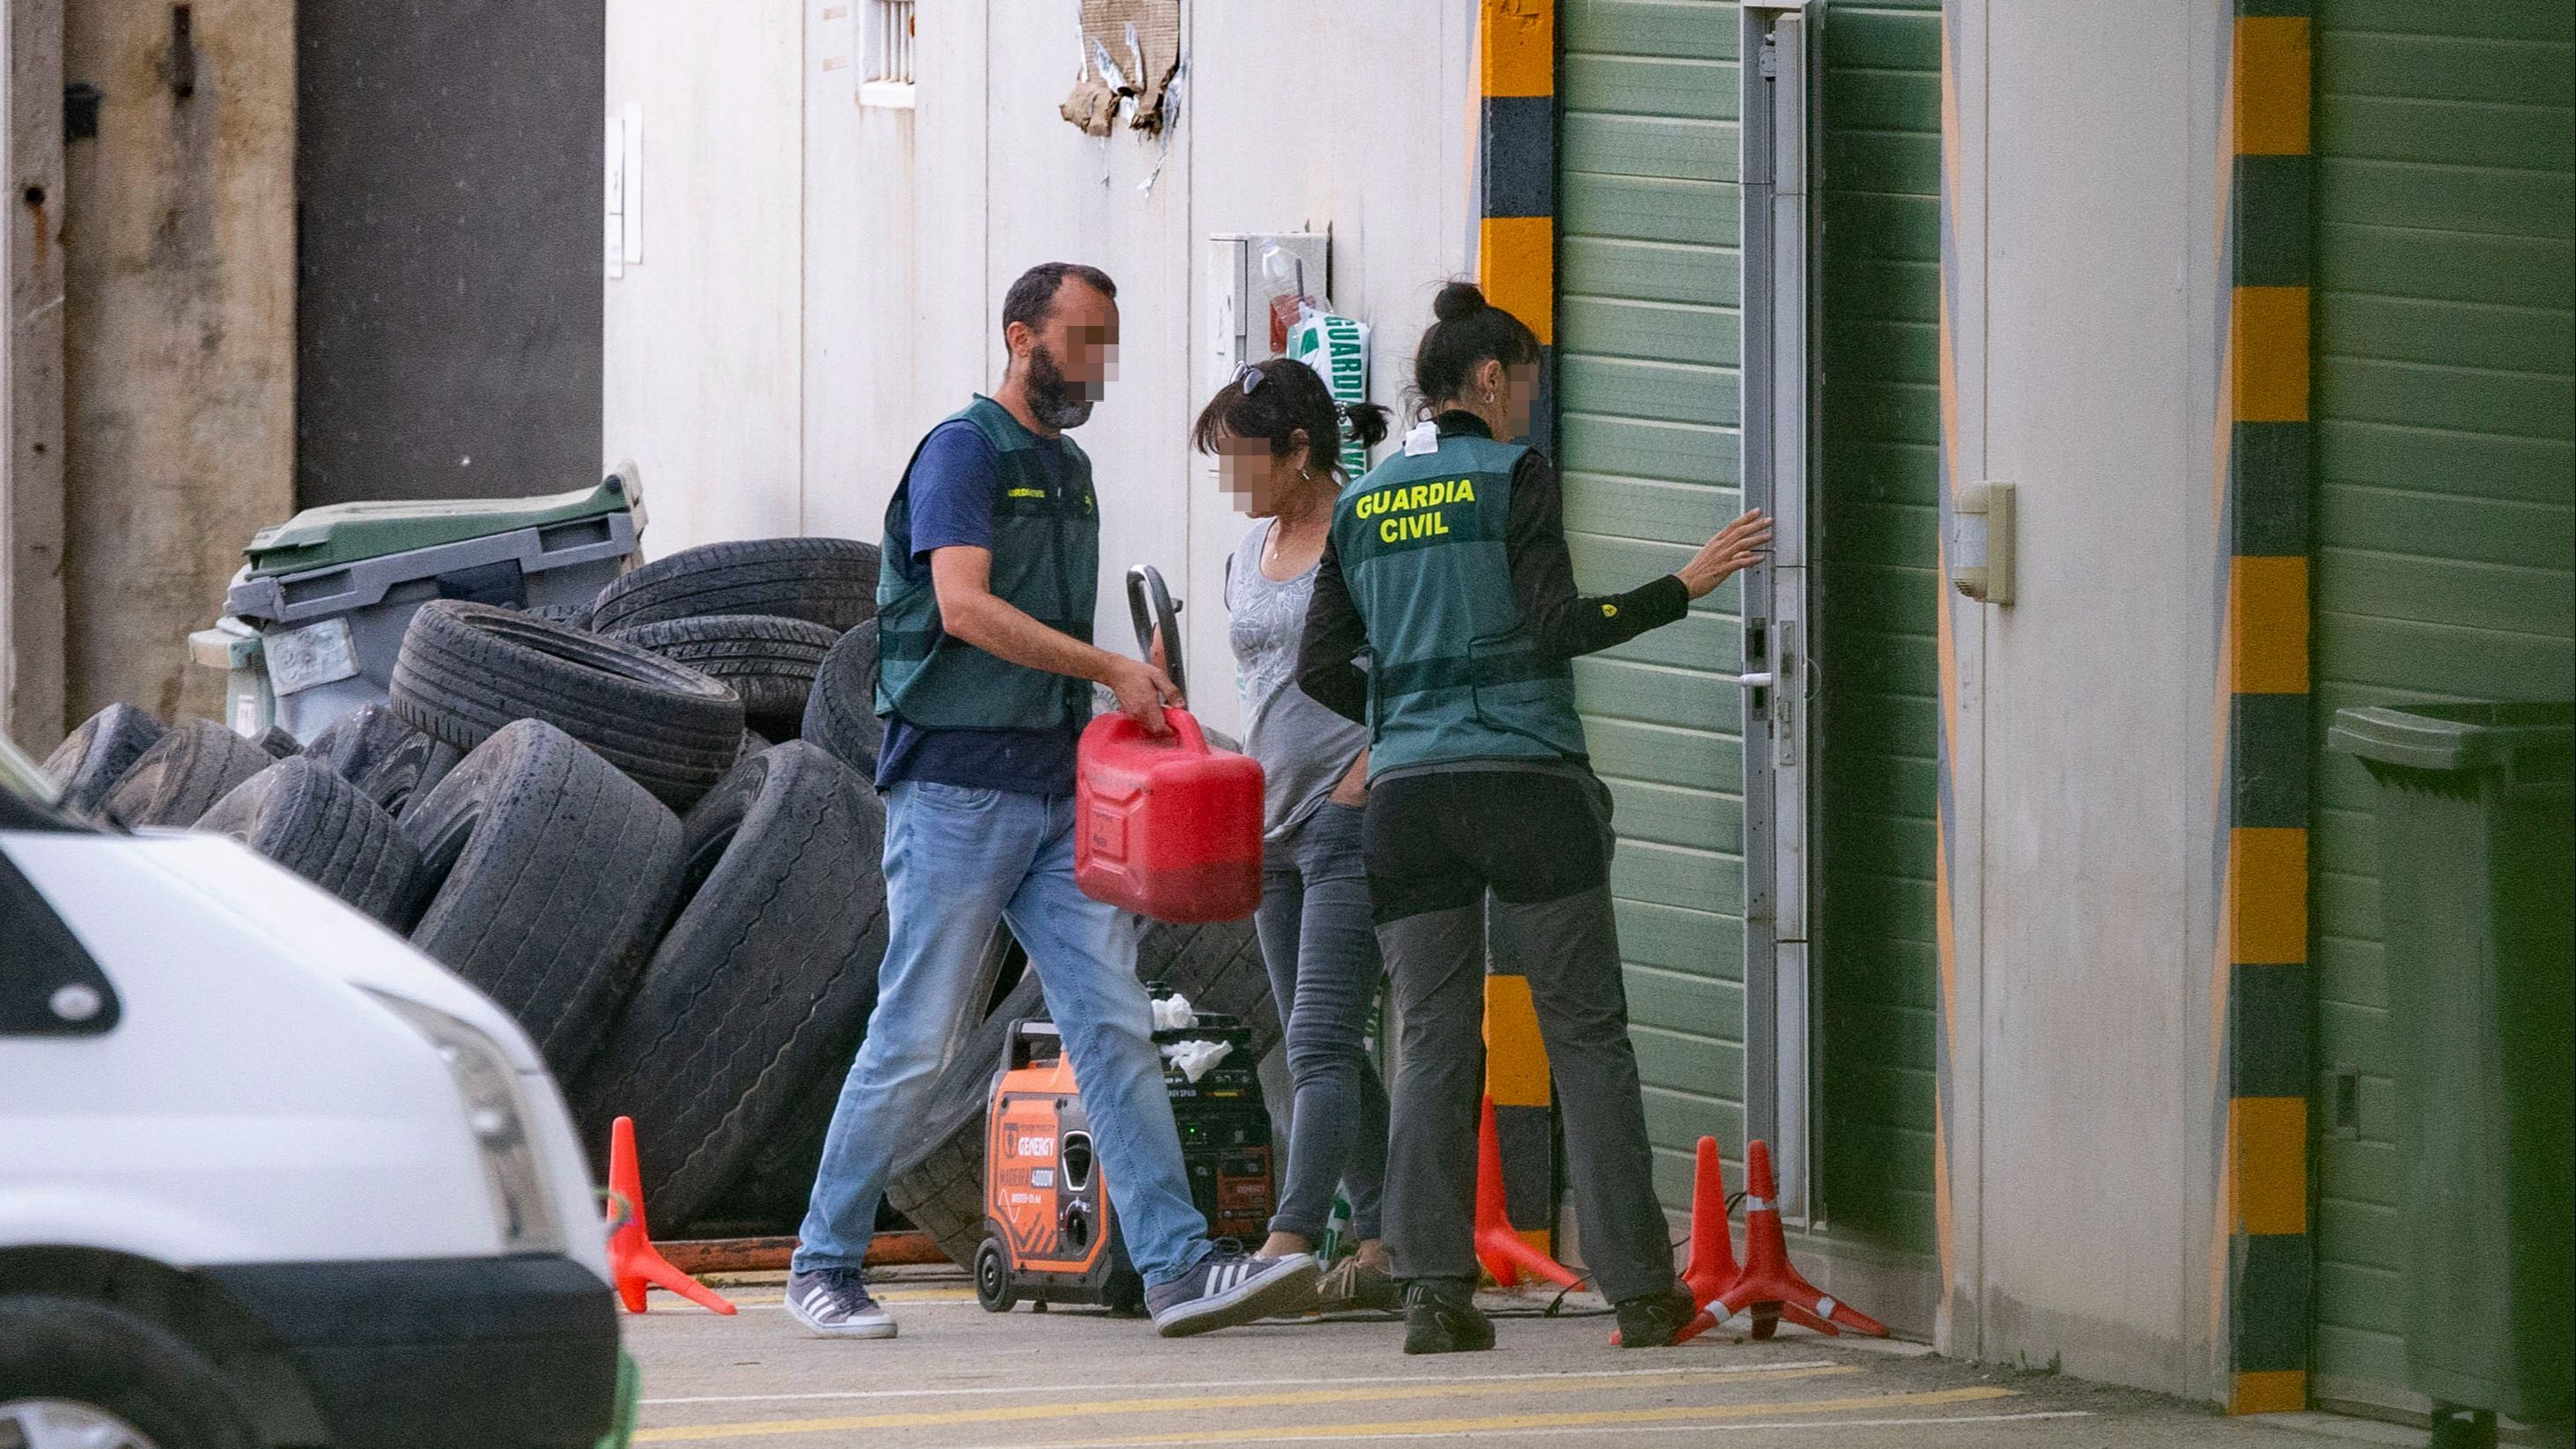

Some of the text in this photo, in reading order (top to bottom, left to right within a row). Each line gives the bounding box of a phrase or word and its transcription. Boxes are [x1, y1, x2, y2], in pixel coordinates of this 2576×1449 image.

[1325, 315, 1363, 406] GUARDI
[1356, 479, 1475, 520] GUARDIA
[1380, 512, 1449, 543] CIVIL
[1018, 1136, 1056, 1157] GENERGY
[1031, 1169, 1054, 1187] 4000W
